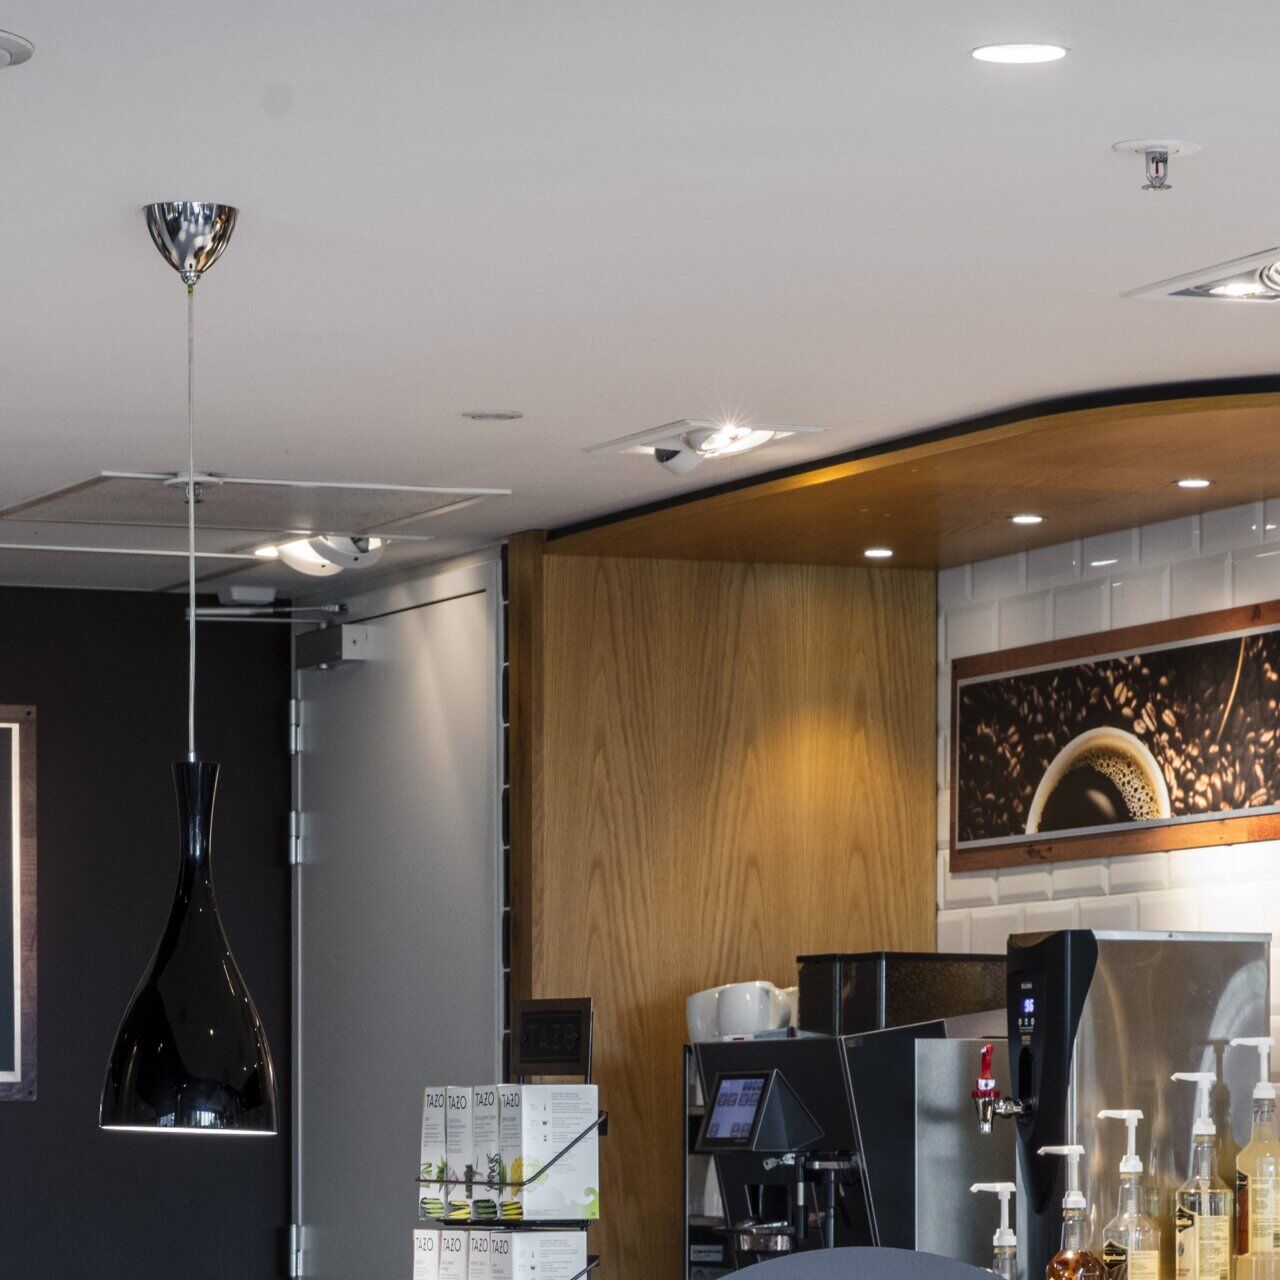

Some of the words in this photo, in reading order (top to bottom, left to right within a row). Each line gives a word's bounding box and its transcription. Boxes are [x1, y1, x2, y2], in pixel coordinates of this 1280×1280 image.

[426, 1094, 445, 1108] TAZO
[448, 1096, 467, 1110] TAZO
[475, 1092, 495, 1106] TAZO
[502, 1093, 520, 1108] TAZO
[415, 1237, 434, 1251] TAZO
[443, 1238, 462, 1252] TAZO
[471, 1238, 489, 1253] TAZO
[492, 1240, 509, 1255] TAZO
